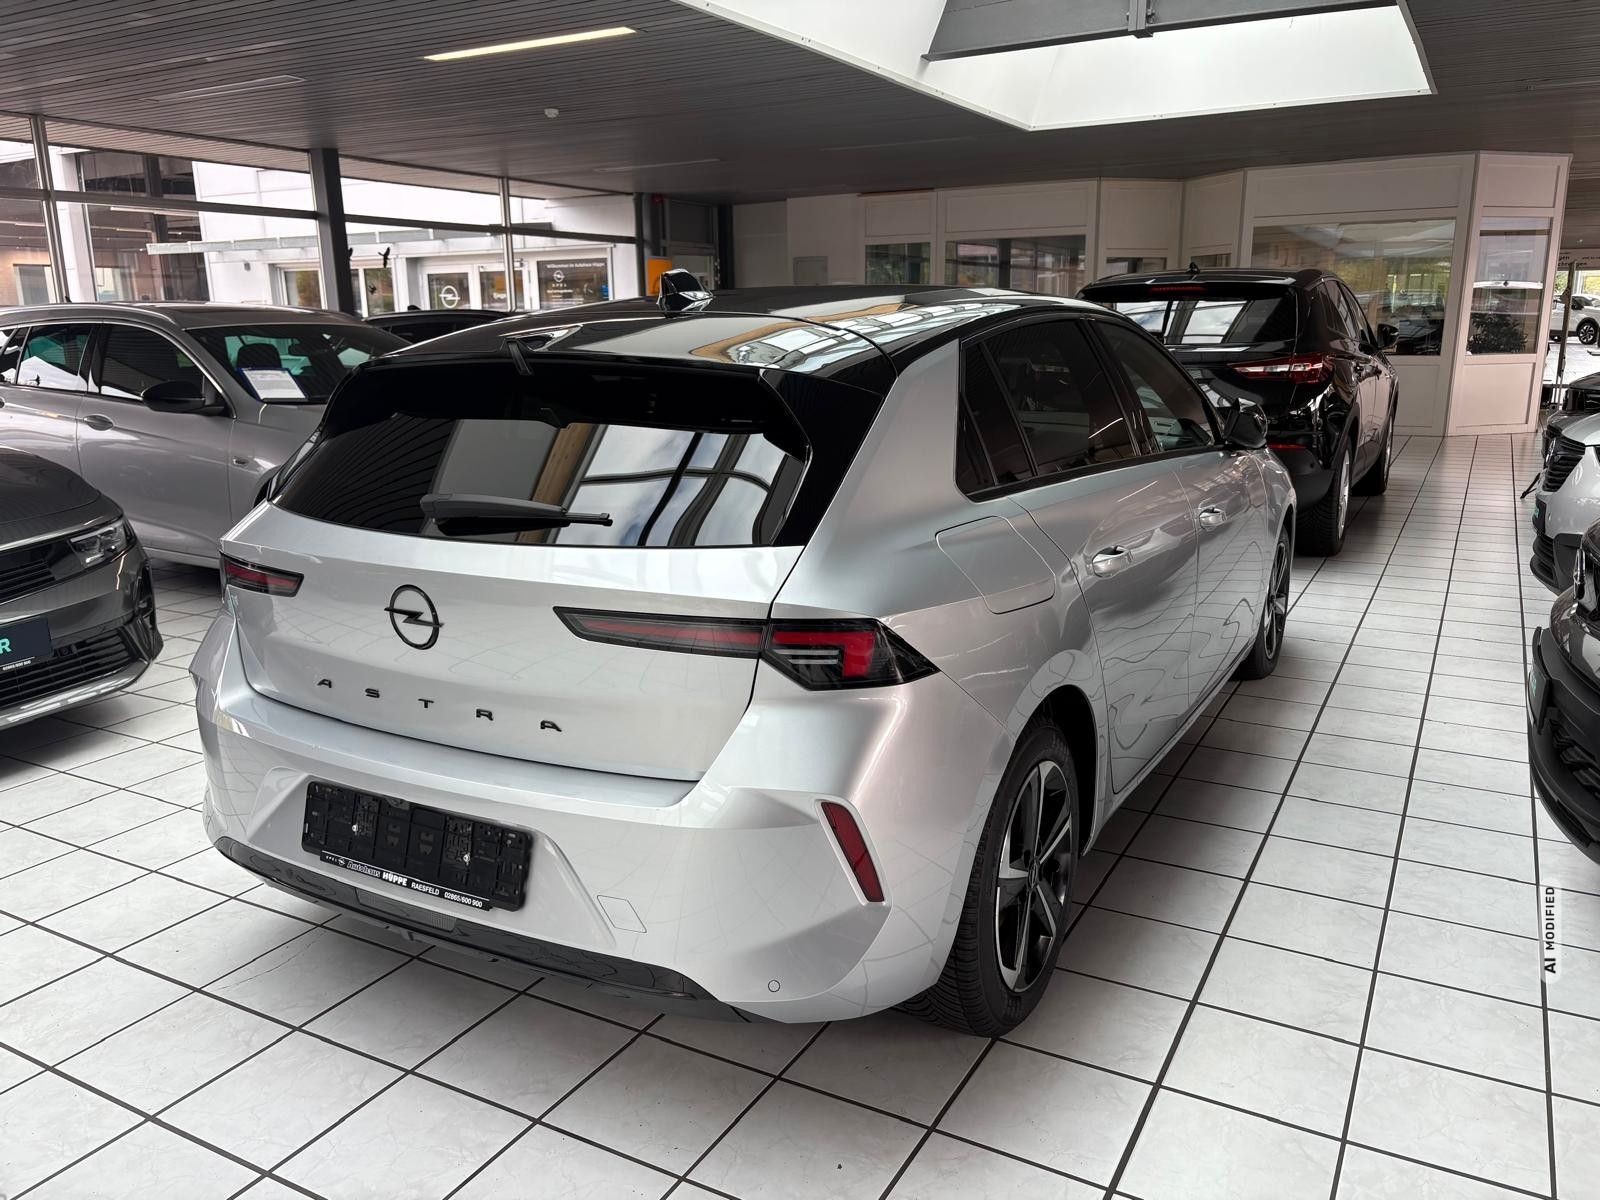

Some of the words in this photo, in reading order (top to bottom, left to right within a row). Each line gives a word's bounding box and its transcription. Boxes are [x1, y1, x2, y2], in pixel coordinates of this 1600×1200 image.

[317, 678, 562, 732] ASTRA
[347, 861, 381, 878] Autohaus
[382, 871, 408, 887] HÜPPE
[411, 881, 440, 896] RAESFELD
[472, 899, 483, 908] 900
